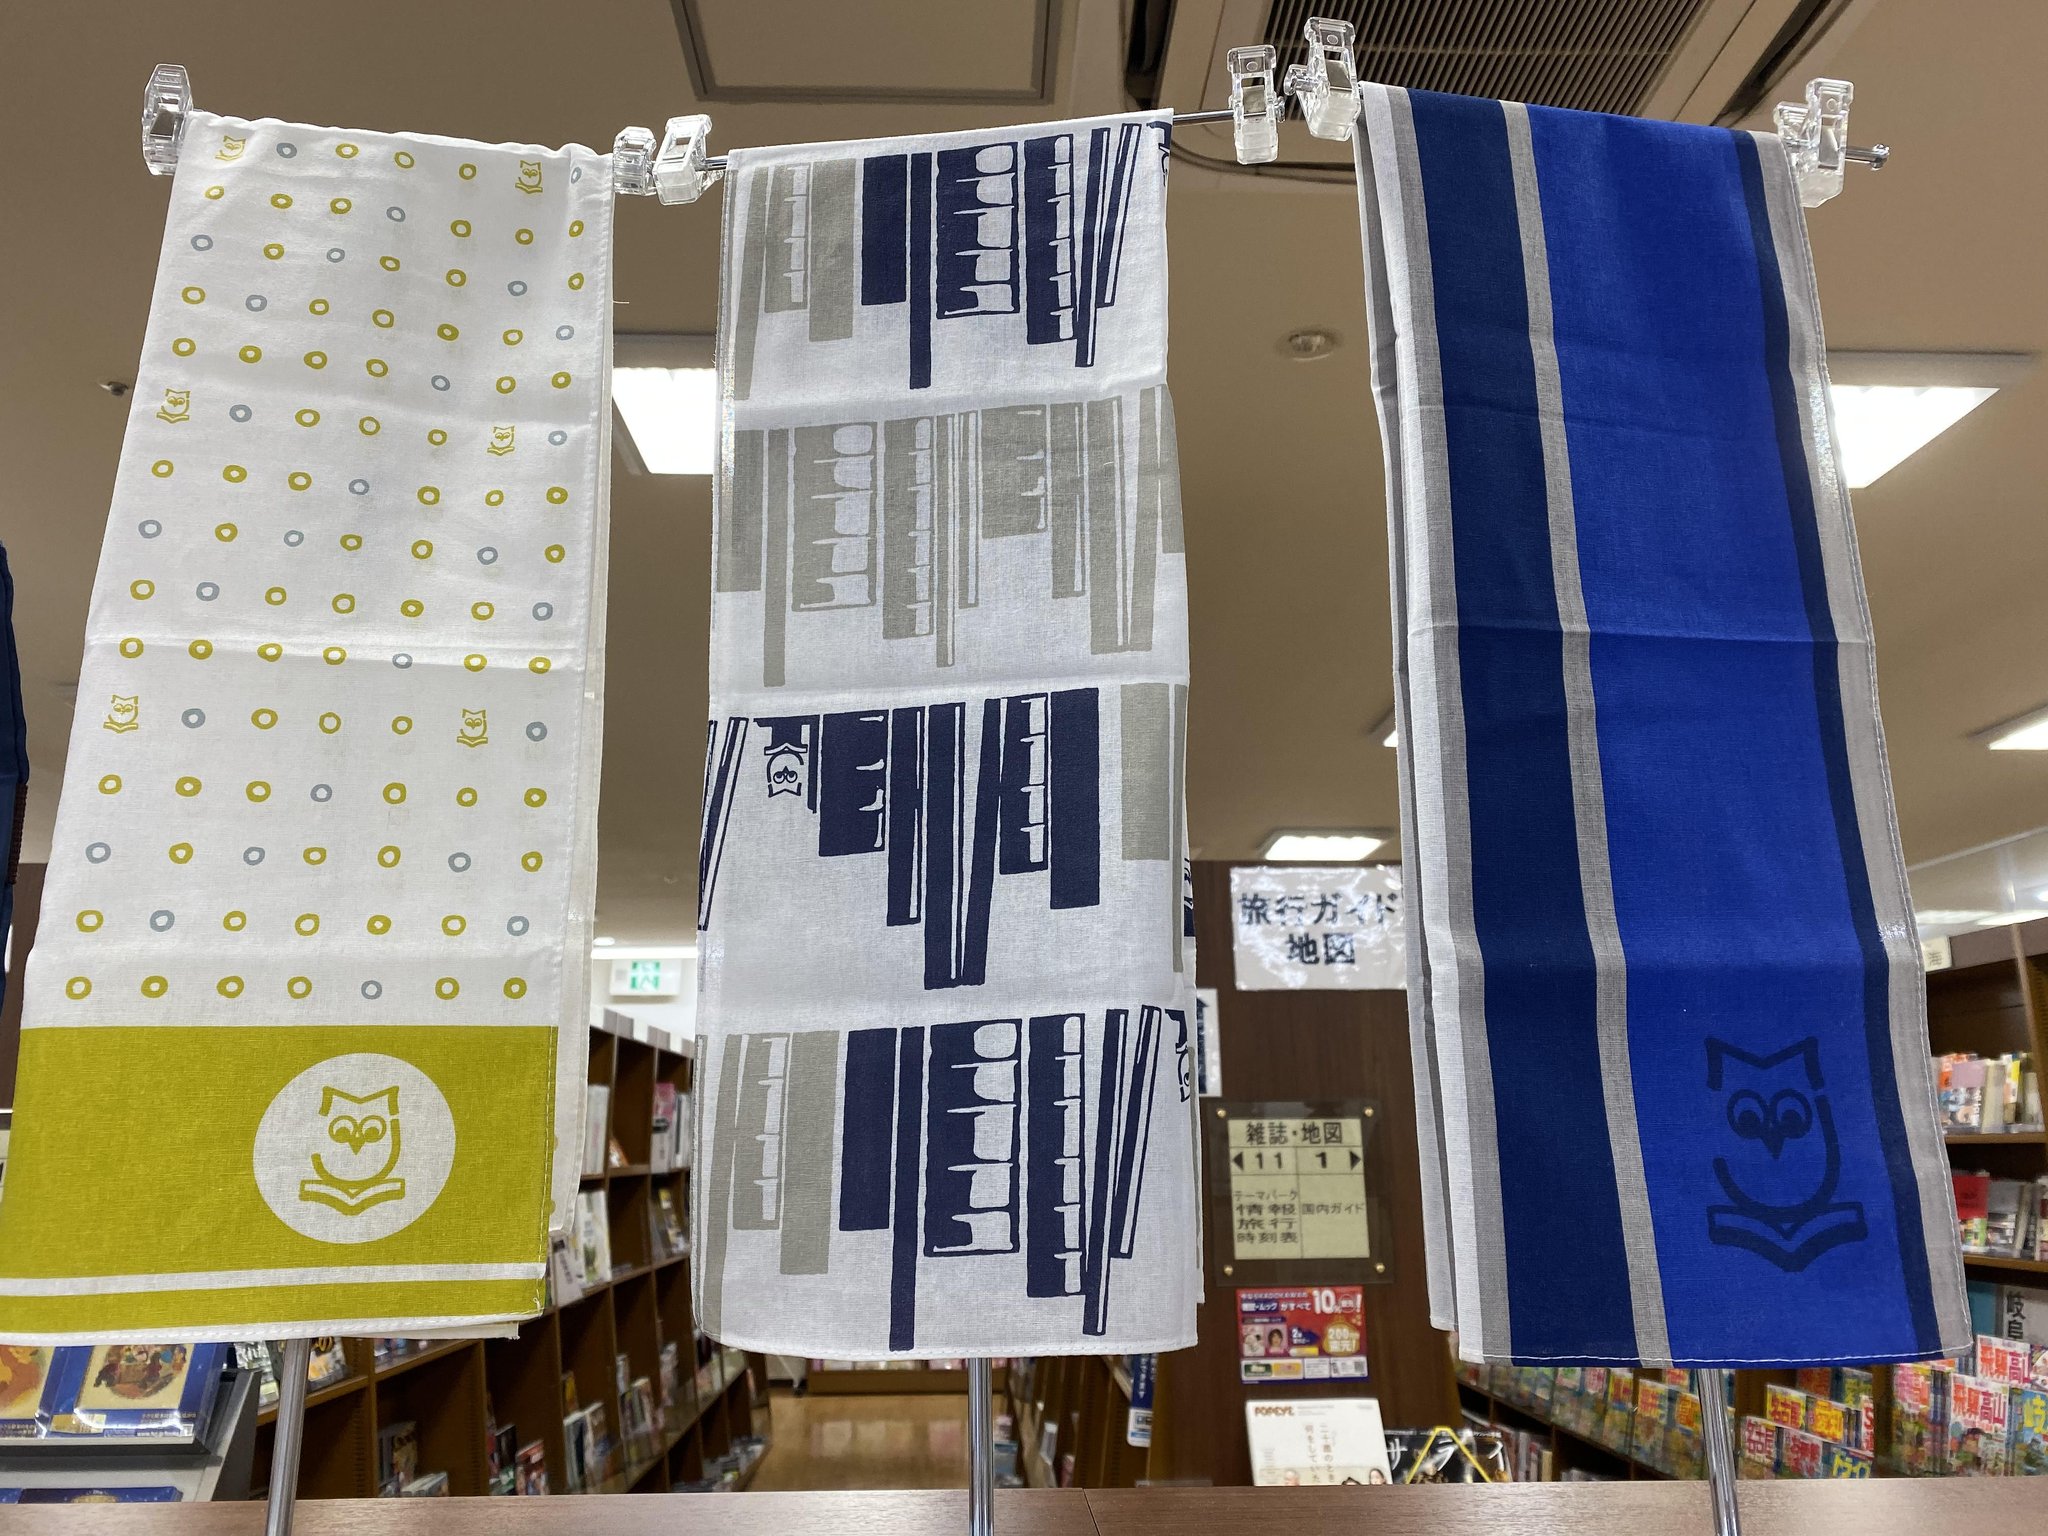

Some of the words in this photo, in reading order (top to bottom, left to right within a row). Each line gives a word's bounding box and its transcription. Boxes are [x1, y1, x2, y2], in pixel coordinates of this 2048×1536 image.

[1237, 892, 1397, 927] 旅行ガイド
[1287, 932, 1356, 965] 地図
[1245, 1121, 1343, 1146] 雑誌・地図
[1315, 1151, 1328, 1170] 1
[2007, 1291, 2026, 1340] 岐阜
[1254, 1406, 1295, 1417] POPEYE
